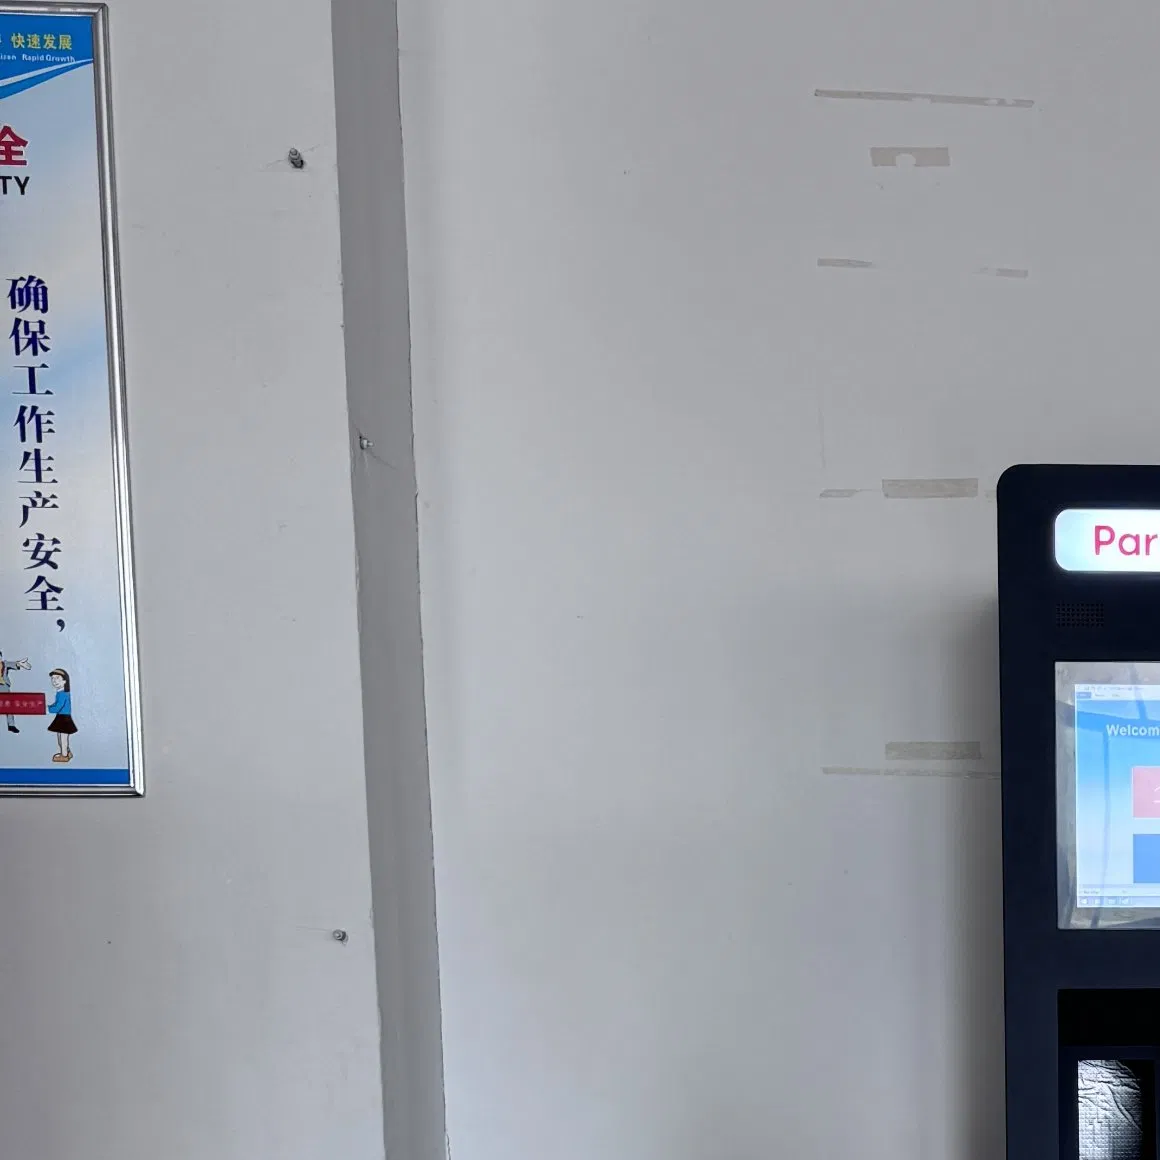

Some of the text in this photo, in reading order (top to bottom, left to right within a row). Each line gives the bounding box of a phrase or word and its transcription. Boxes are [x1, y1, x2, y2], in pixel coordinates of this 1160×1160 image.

[11, 32, 72, 50] 快速发展
[22, 53, 44, 62] Rapid
[45, 55, 76, 63] Growth
[0, 125, 29, 166] 全
[0, 175, 30, 195] TY
